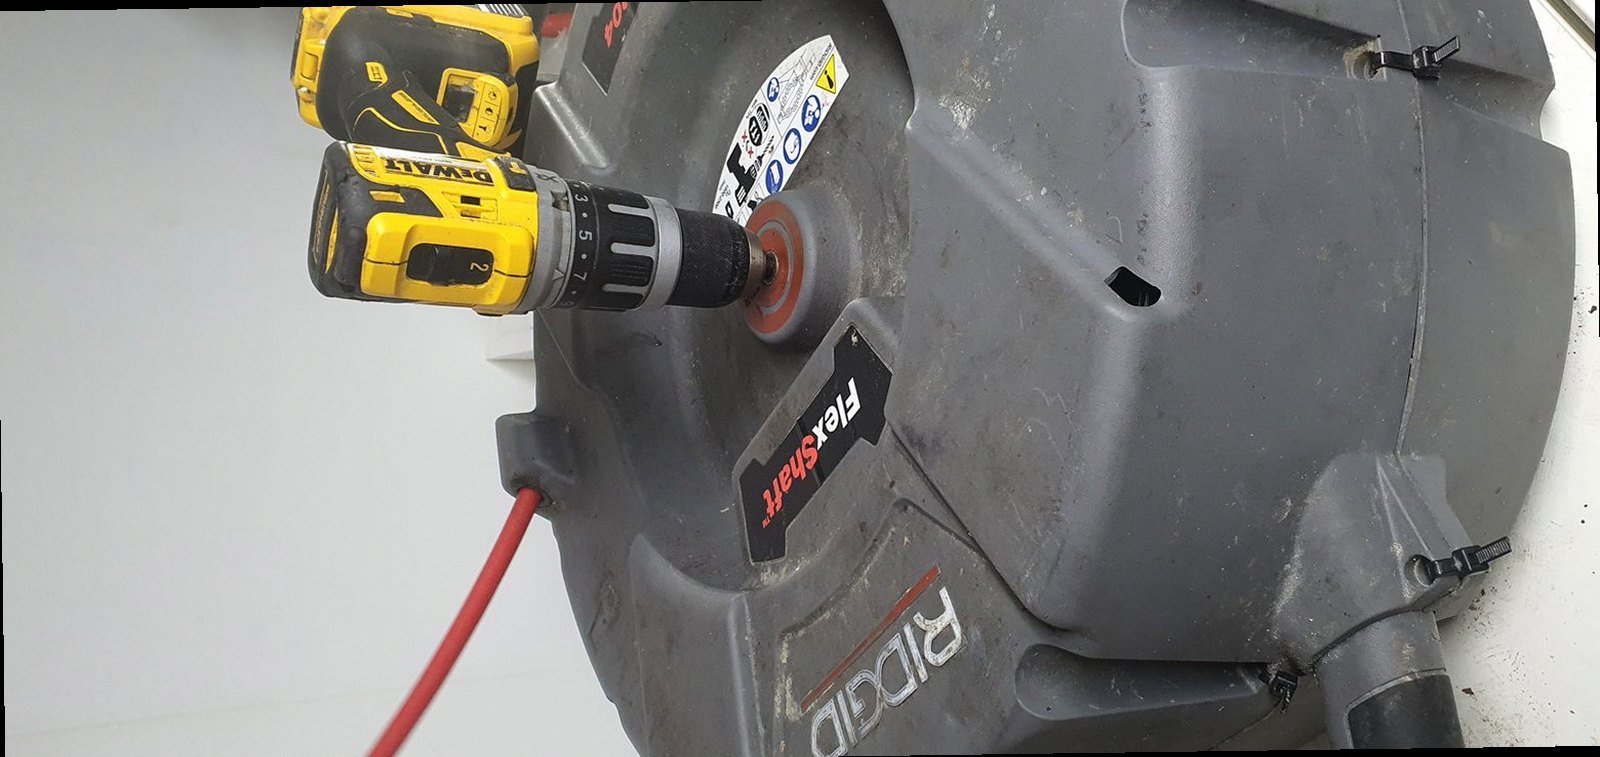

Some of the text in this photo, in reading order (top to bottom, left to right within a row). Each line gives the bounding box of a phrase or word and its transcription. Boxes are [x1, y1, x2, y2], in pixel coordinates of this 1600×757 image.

[575, 193, 589, 204] 3
[579, 229, 593, 241] 5
[470, 262, 489, 273] 2
[573, 271, 588, 282] 7
[811, 586, 963, 756] RIDGID
